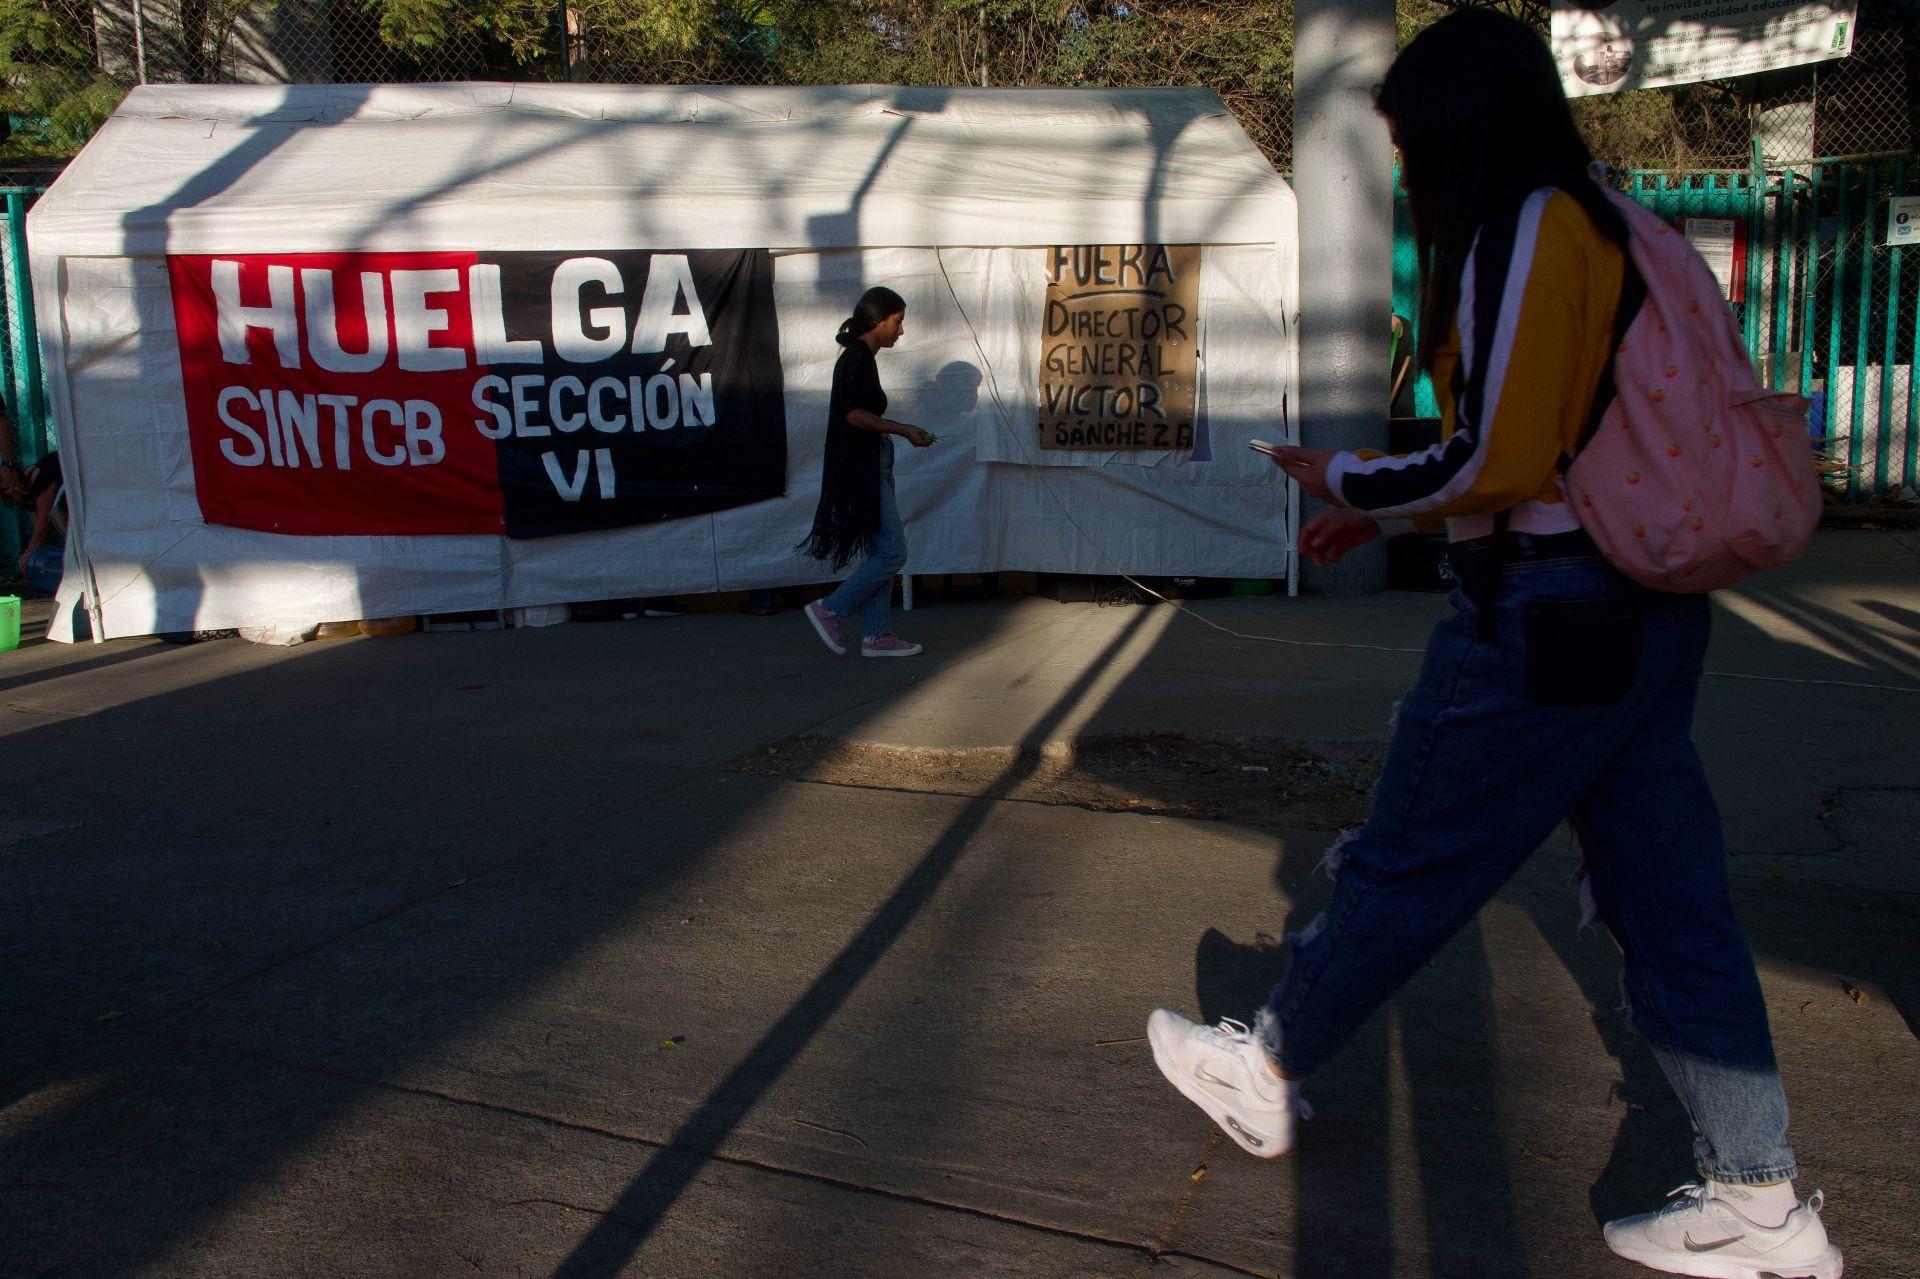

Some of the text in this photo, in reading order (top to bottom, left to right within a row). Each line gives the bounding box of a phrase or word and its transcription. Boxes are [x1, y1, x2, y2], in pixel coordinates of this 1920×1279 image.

[1646, 5, 1660, 14] te
[1664, 0, 1701, 12] invita
[1681, 3, 1749, 21] modalidad
[1752, 0, 1815, 11] educati
[1054, 245, 1176, 287] FUERA
[210, 253, 712, 374] HUELGA
[1047, 299, 1188, 341] DIRECTOR
[1045, 343, 1176, 378] GENERAL
[217, 358, 716, 471] SINTCB SECCIÓN
[1044, 380, 1168, 420] VICTOR
[541, 447, 616, 500] VI
